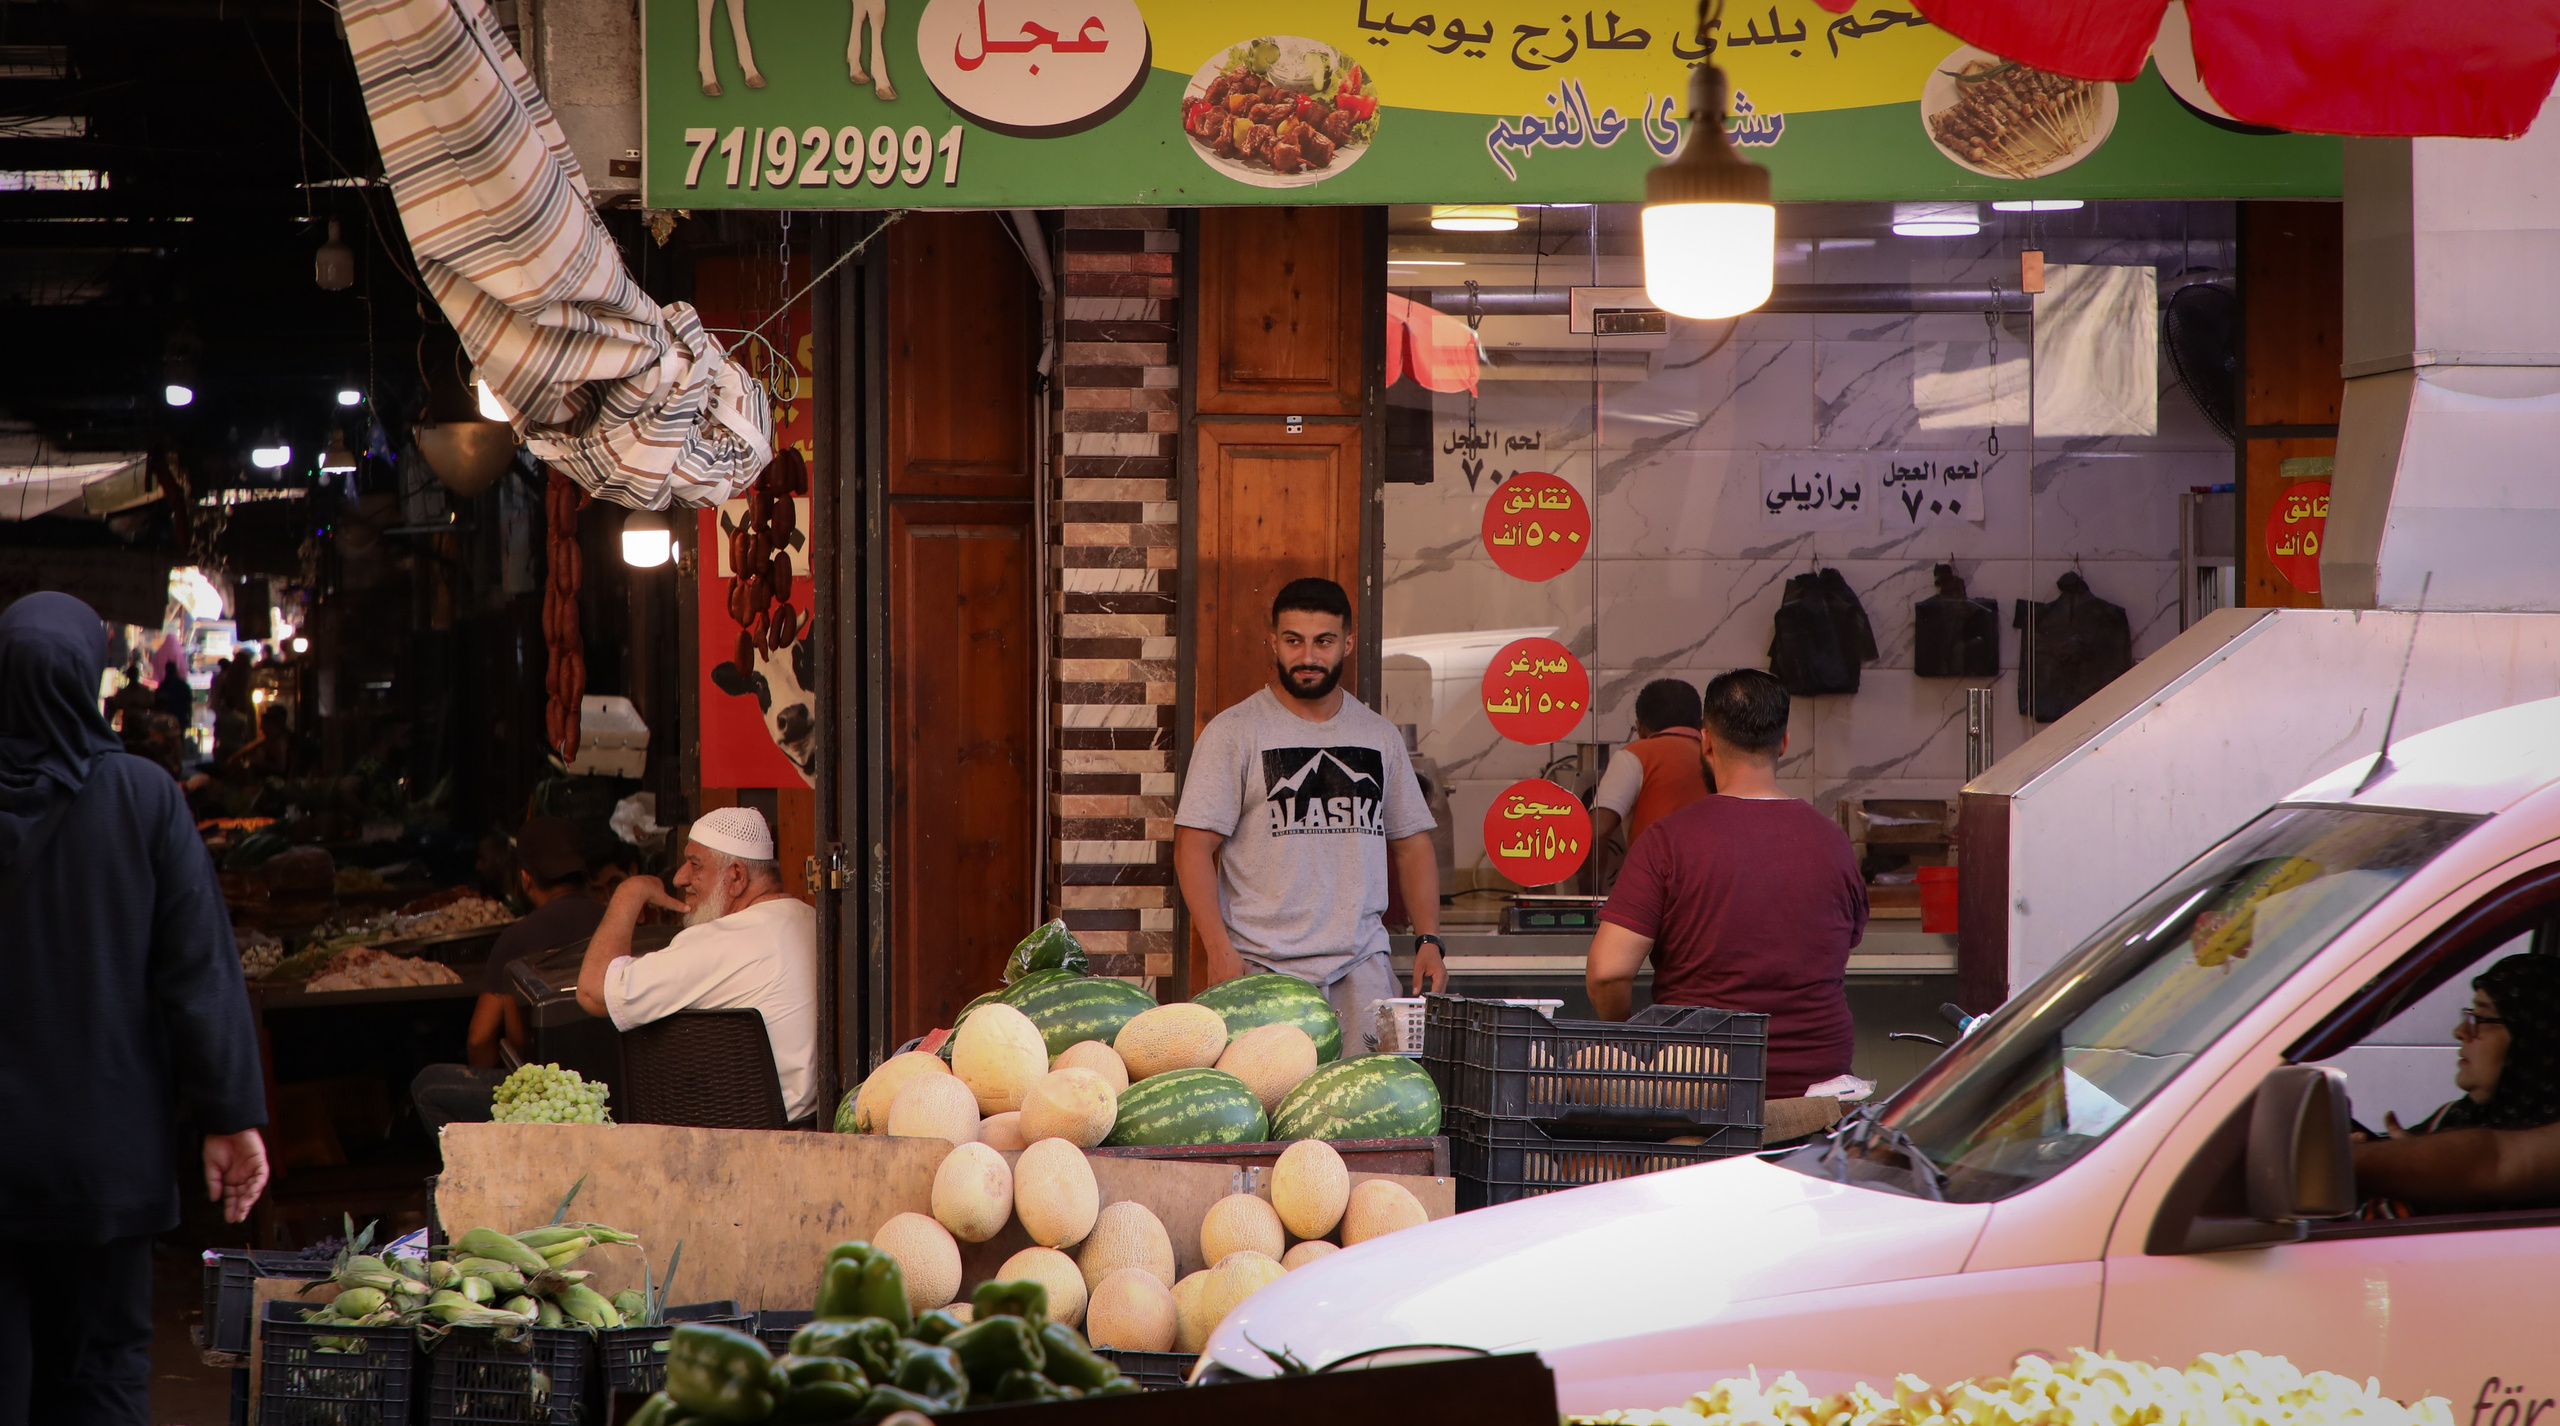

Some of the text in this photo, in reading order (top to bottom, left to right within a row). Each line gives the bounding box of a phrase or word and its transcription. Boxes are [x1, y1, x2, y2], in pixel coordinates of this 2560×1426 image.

[954, 0, 1110, 76] عجل
[1357, 0, 1933, 71] حم بلدي طازج يوميا
[1488, 78, 1627, 180] عالفحم
[683, 124, 965, 188] 71/929991
[1442, 429, 1542, 456] لحم العجل
[1882, 459, 1979, 488] لحم العجل
[1502, 486, 1573, 514] نقانق
[1765, 471, 1862, 514] برازيلي
[1901, 489, 1962, 524] ٧٠٠
[2283, 496, 2330, 524] قانق
[1492, 520, 1581, 547] ٥٠٠ ألف
[2274, 531, 2301, 556] ألف
[1503, 649, 1570, 680] همبرغر
[1485, 686, 1581, 714] ٥٠٠ ألف
[1267, 796, 1384, 828] ALASKA
[1502, 794, 1573, 820] سجق
[1499, 825, 1579, 860] ٥٠٠ ألف
[2470, 1375, 2556, 1426] för
